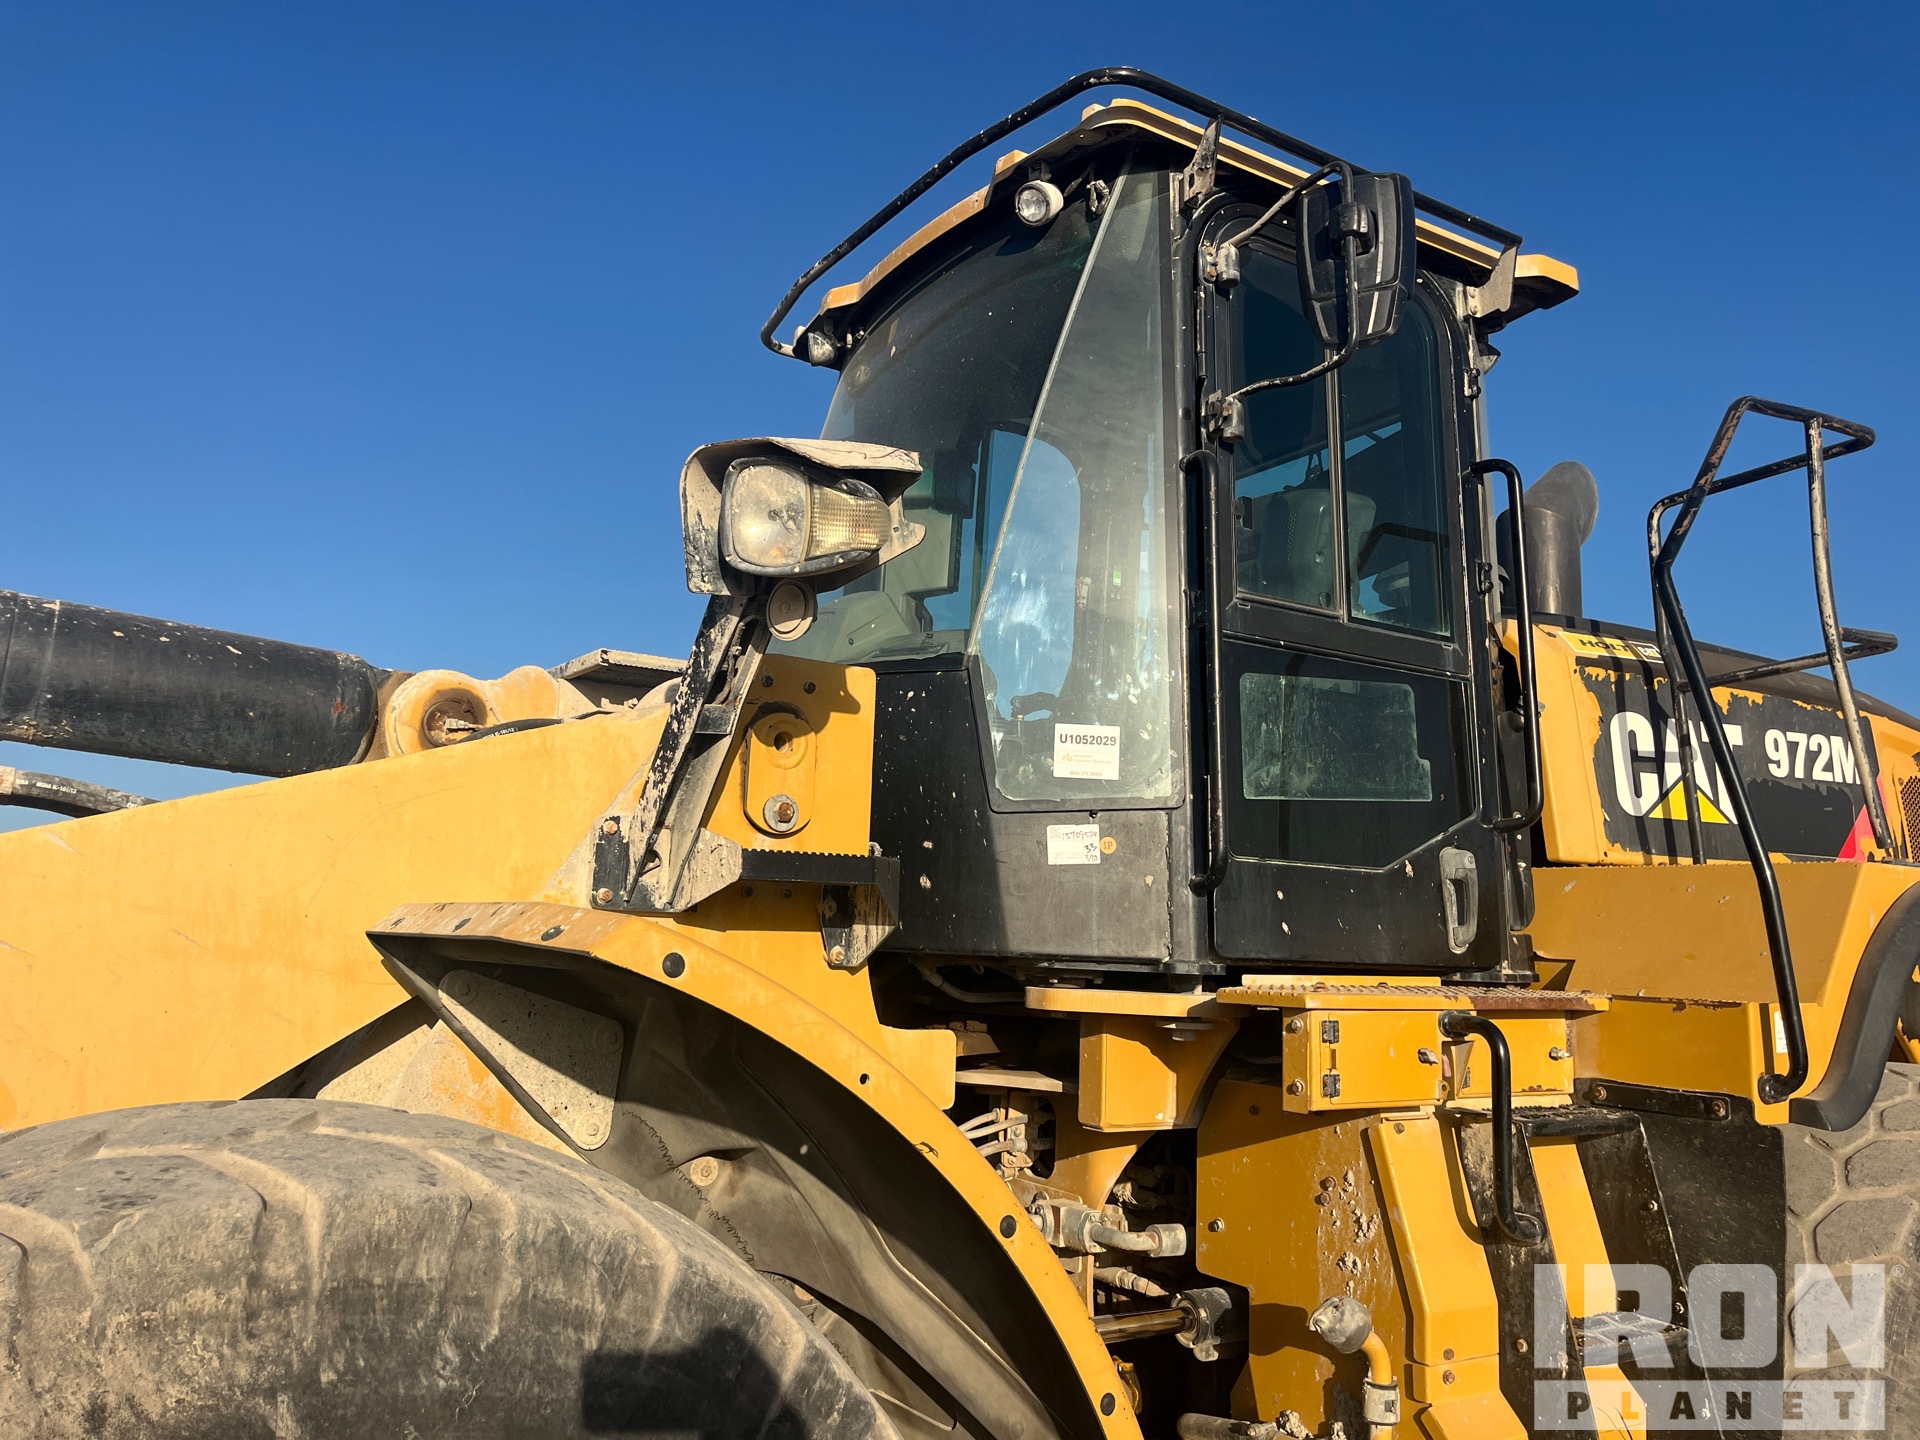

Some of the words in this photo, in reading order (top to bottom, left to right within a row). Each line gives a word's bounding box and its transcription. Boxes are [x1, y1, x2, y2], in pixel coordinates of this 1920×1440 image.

[1578, 638, 1629, 652] HOLT
[1059, 733, 1117, 746] U1052029
[1609, 711, 1744, 825] CAT
[1764, 729, 1862, 785] 972M
